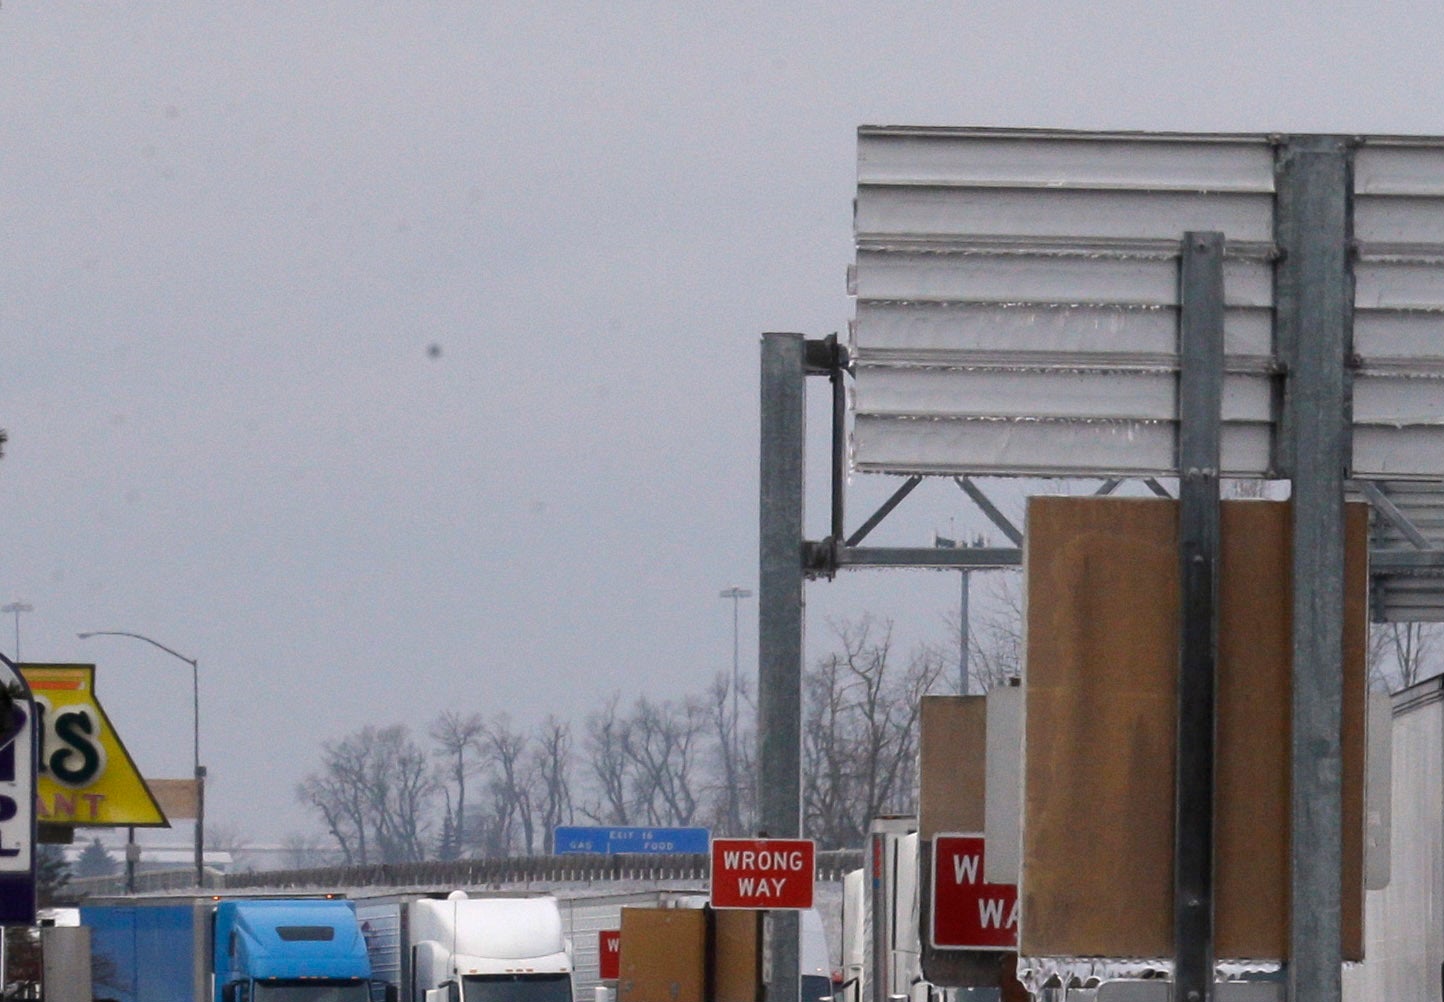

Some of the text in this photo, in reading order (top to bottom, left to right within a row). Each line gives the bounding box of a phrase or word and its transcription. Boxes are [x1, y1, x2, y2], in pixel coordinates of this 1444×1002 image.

[569, 841, 674, 850] GAS FOOD
[723, 851, 803, 871] WRONG
[738, 878, 787, 897] WAY
